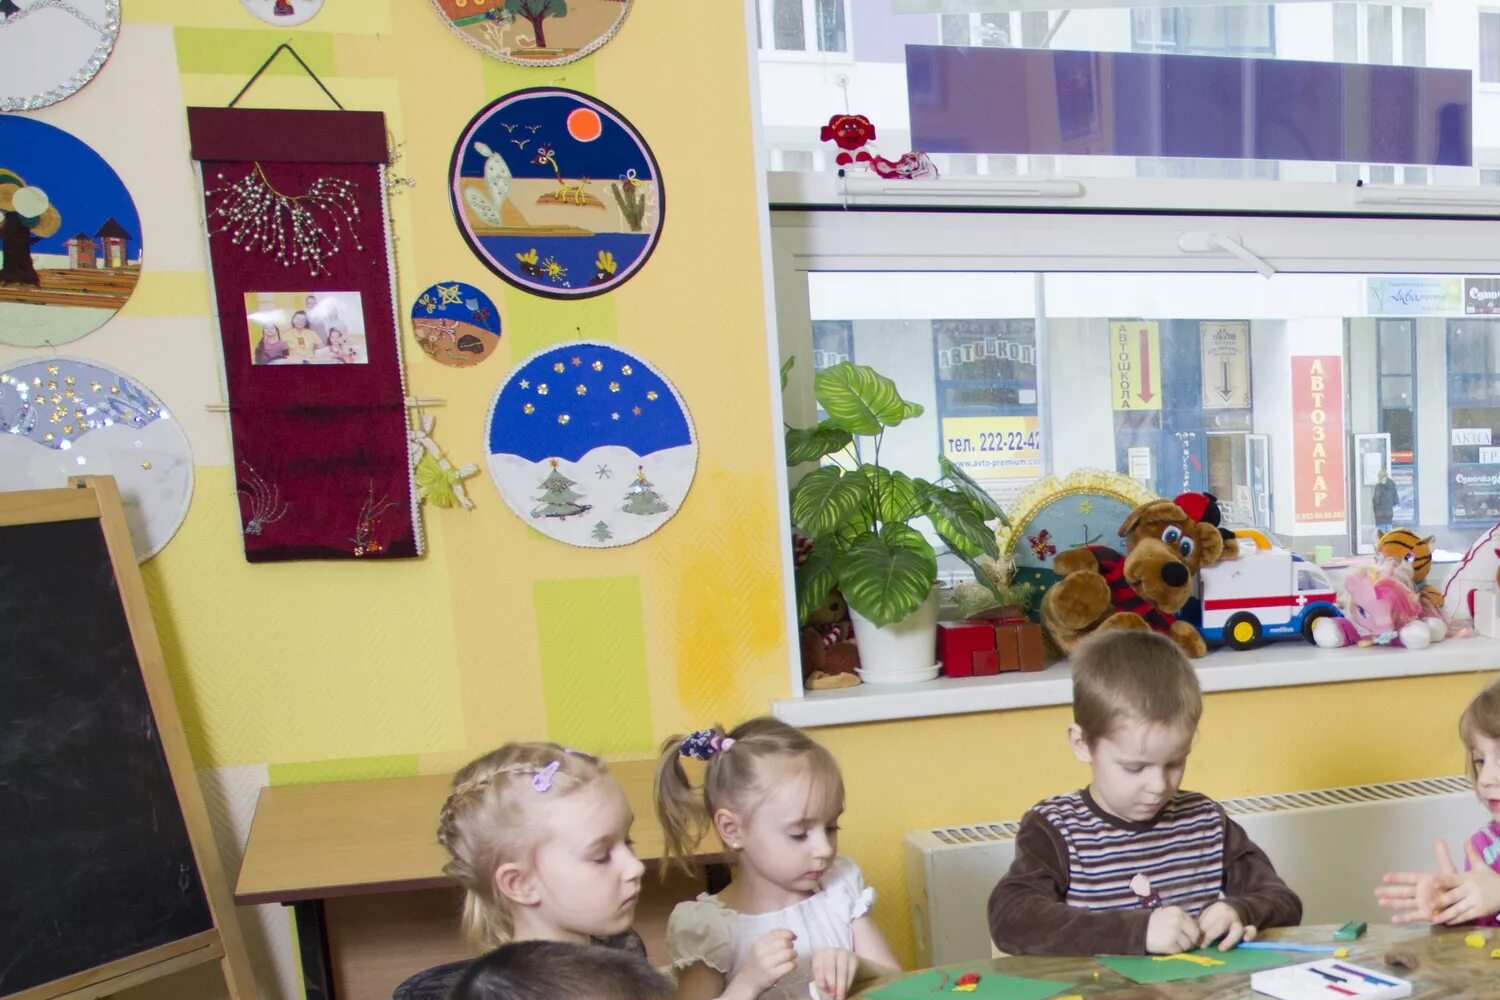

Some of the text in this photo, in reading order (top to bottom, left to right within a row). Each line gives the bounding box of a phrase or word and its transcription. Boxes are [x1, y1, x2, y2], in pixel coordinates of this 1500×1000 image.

[1118, 324, 1131, 409] АВТОШКОЛА
[948, 438, 975, 453] тел.
[1310, 359, 1328, 507] АВТОЗАГАР
